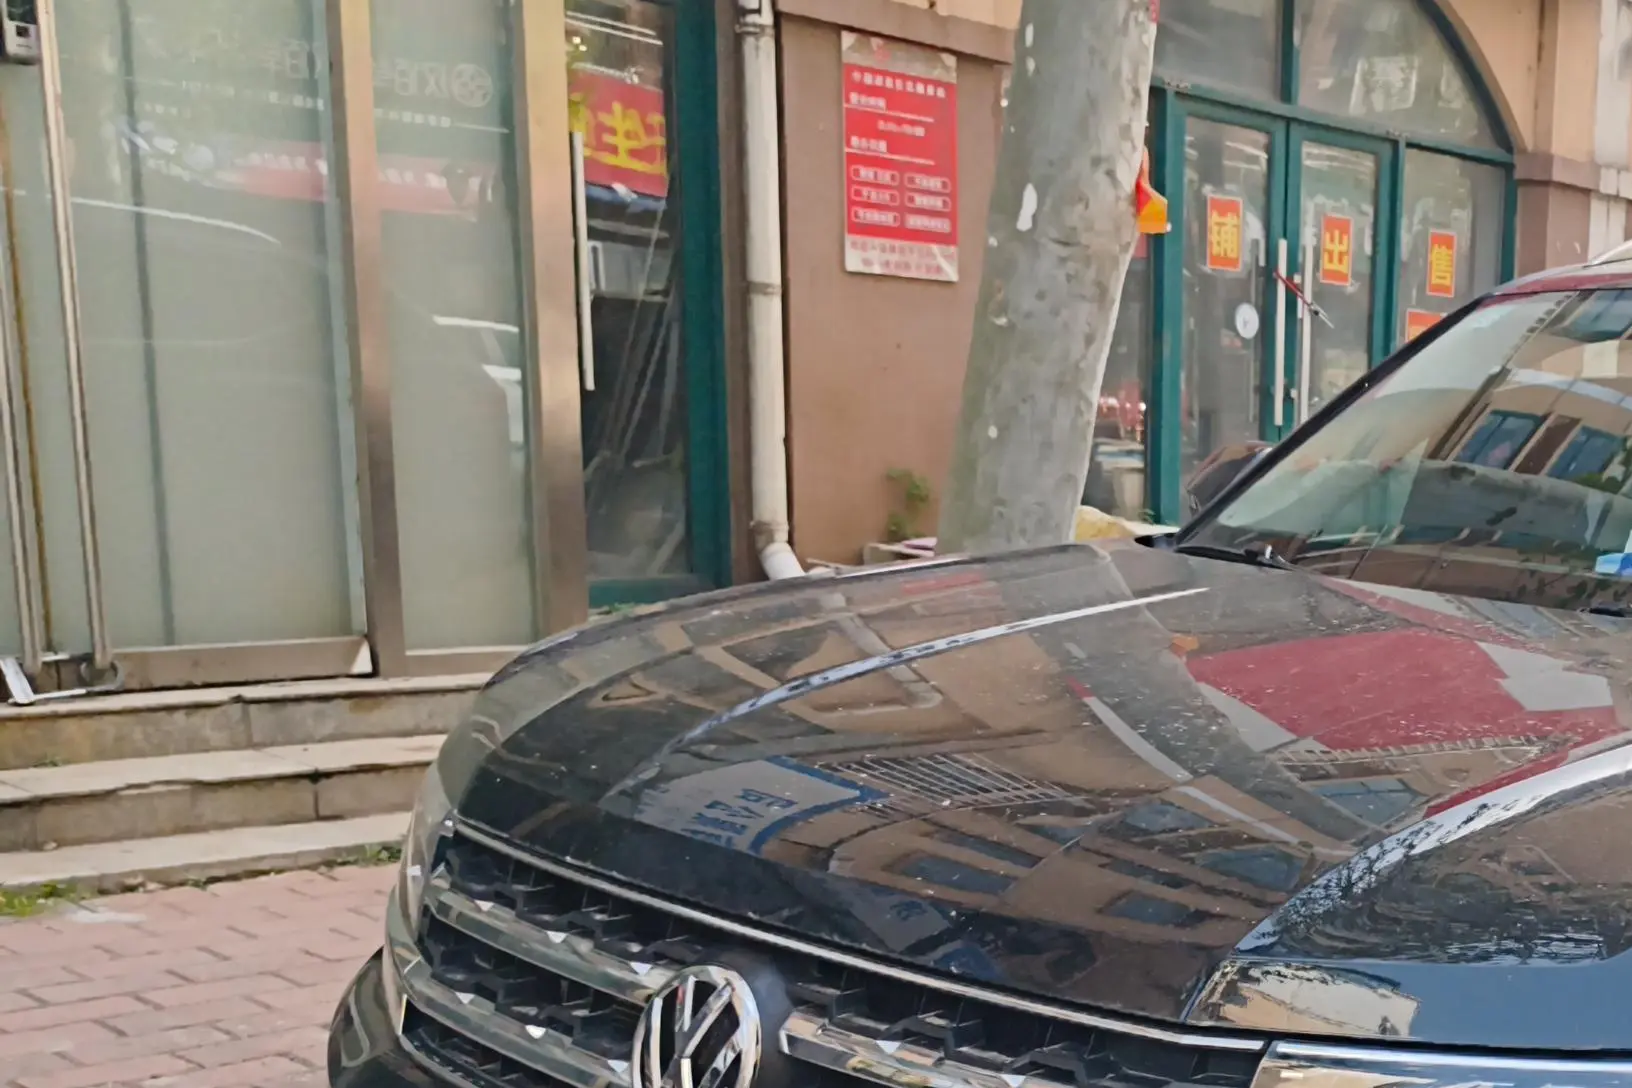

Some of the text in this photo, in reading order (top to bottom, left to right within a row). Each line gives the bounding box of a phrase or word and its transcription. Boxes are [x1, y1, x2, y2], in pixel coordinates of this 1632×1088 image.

[1209, 209, 1453, 287] 铺 出 售
